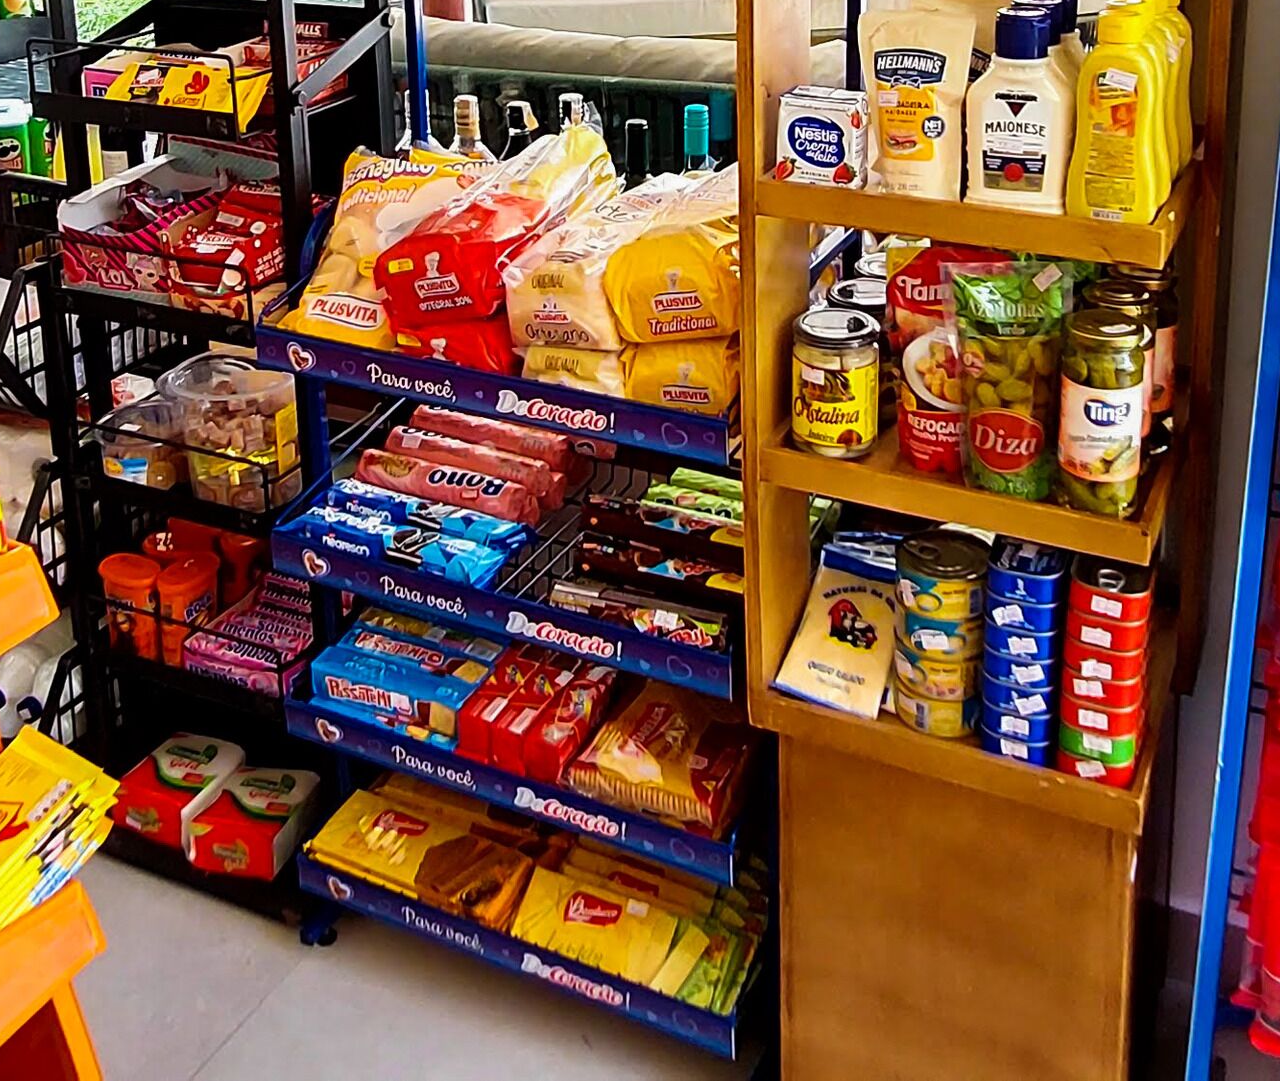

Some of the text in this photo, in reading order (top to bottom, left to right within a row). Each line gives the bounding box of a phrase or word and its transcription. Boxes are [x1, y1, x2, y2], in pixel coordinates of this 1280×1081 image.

[295, 24, 322, 36] ALLS
[877, 54, 943, 74] HELLMANN'S
[985, 121, 1047, 138] MAIONESE
[419, 279, 456, 293] PLUSVITA
[311, 297, 379, 324] PLUSVITA
[654, 295, 702, 310] PLUSVITA
[649, 314, 718, 334] Tradicional
[366, 363, 412, 392] Para
[415, 378, 458, 403] você,
[662, 390, 711, 402] PLUSVITA
[1086, 401, 1132, 423] Ting
[975, 424, 1038, 456] Diza
[428, 469, 509, 497] Bono
[378, 575, 425, 604] Para
[426, 591, 468, 618] você,
[391, 745, 436, 775] Para
[437, 765, 478, 792] você,
[402, 904, 444, 937] Para
